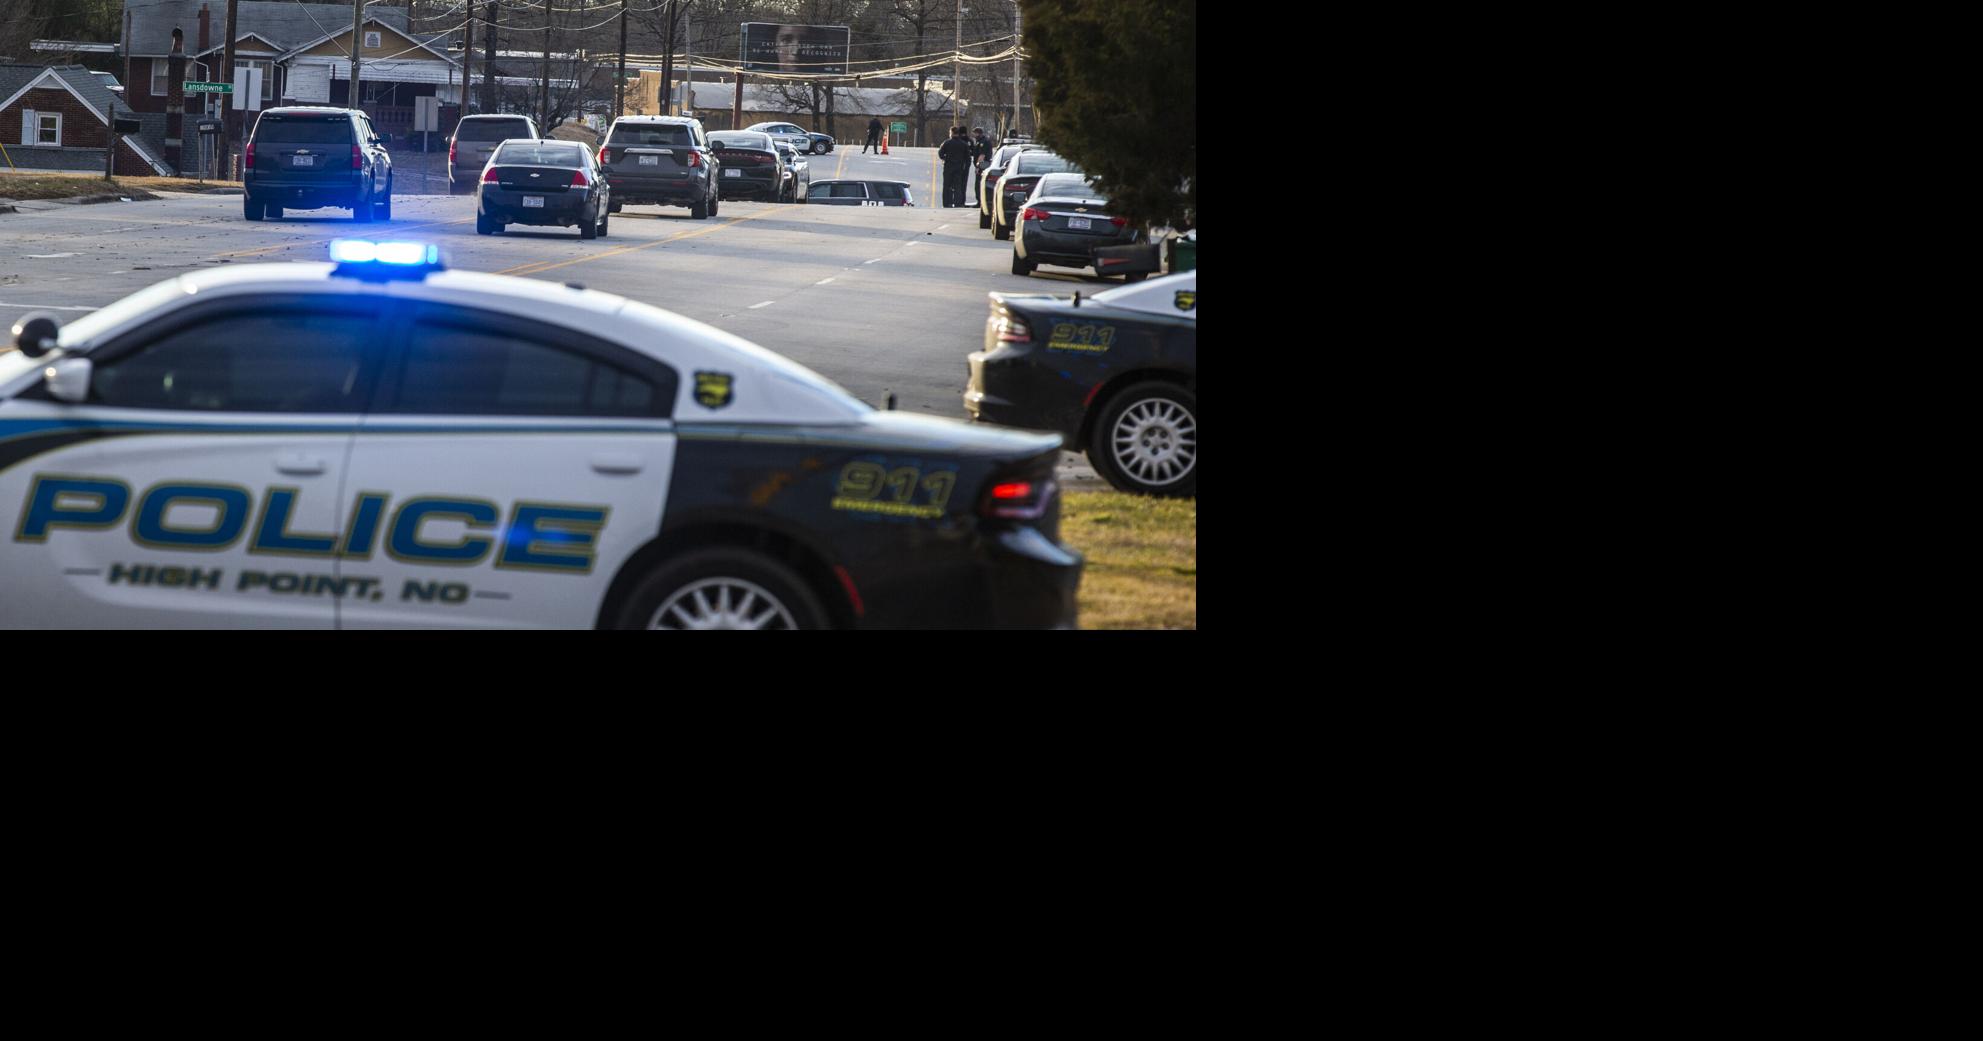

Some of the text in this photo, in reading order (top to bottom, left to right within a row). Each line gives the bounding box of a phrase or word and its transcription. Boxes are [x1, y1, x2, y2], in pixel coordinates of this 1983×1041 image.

[184, 83, 223, 92] Lansdowne
[1051, 322, 1116, 346] 911
[837, 460, 957, 508] 911
[12, 472, 612, 576] POLICE
[106, 562, 222, 590] HIGH
[236, 569, 384, 601] POINT,
